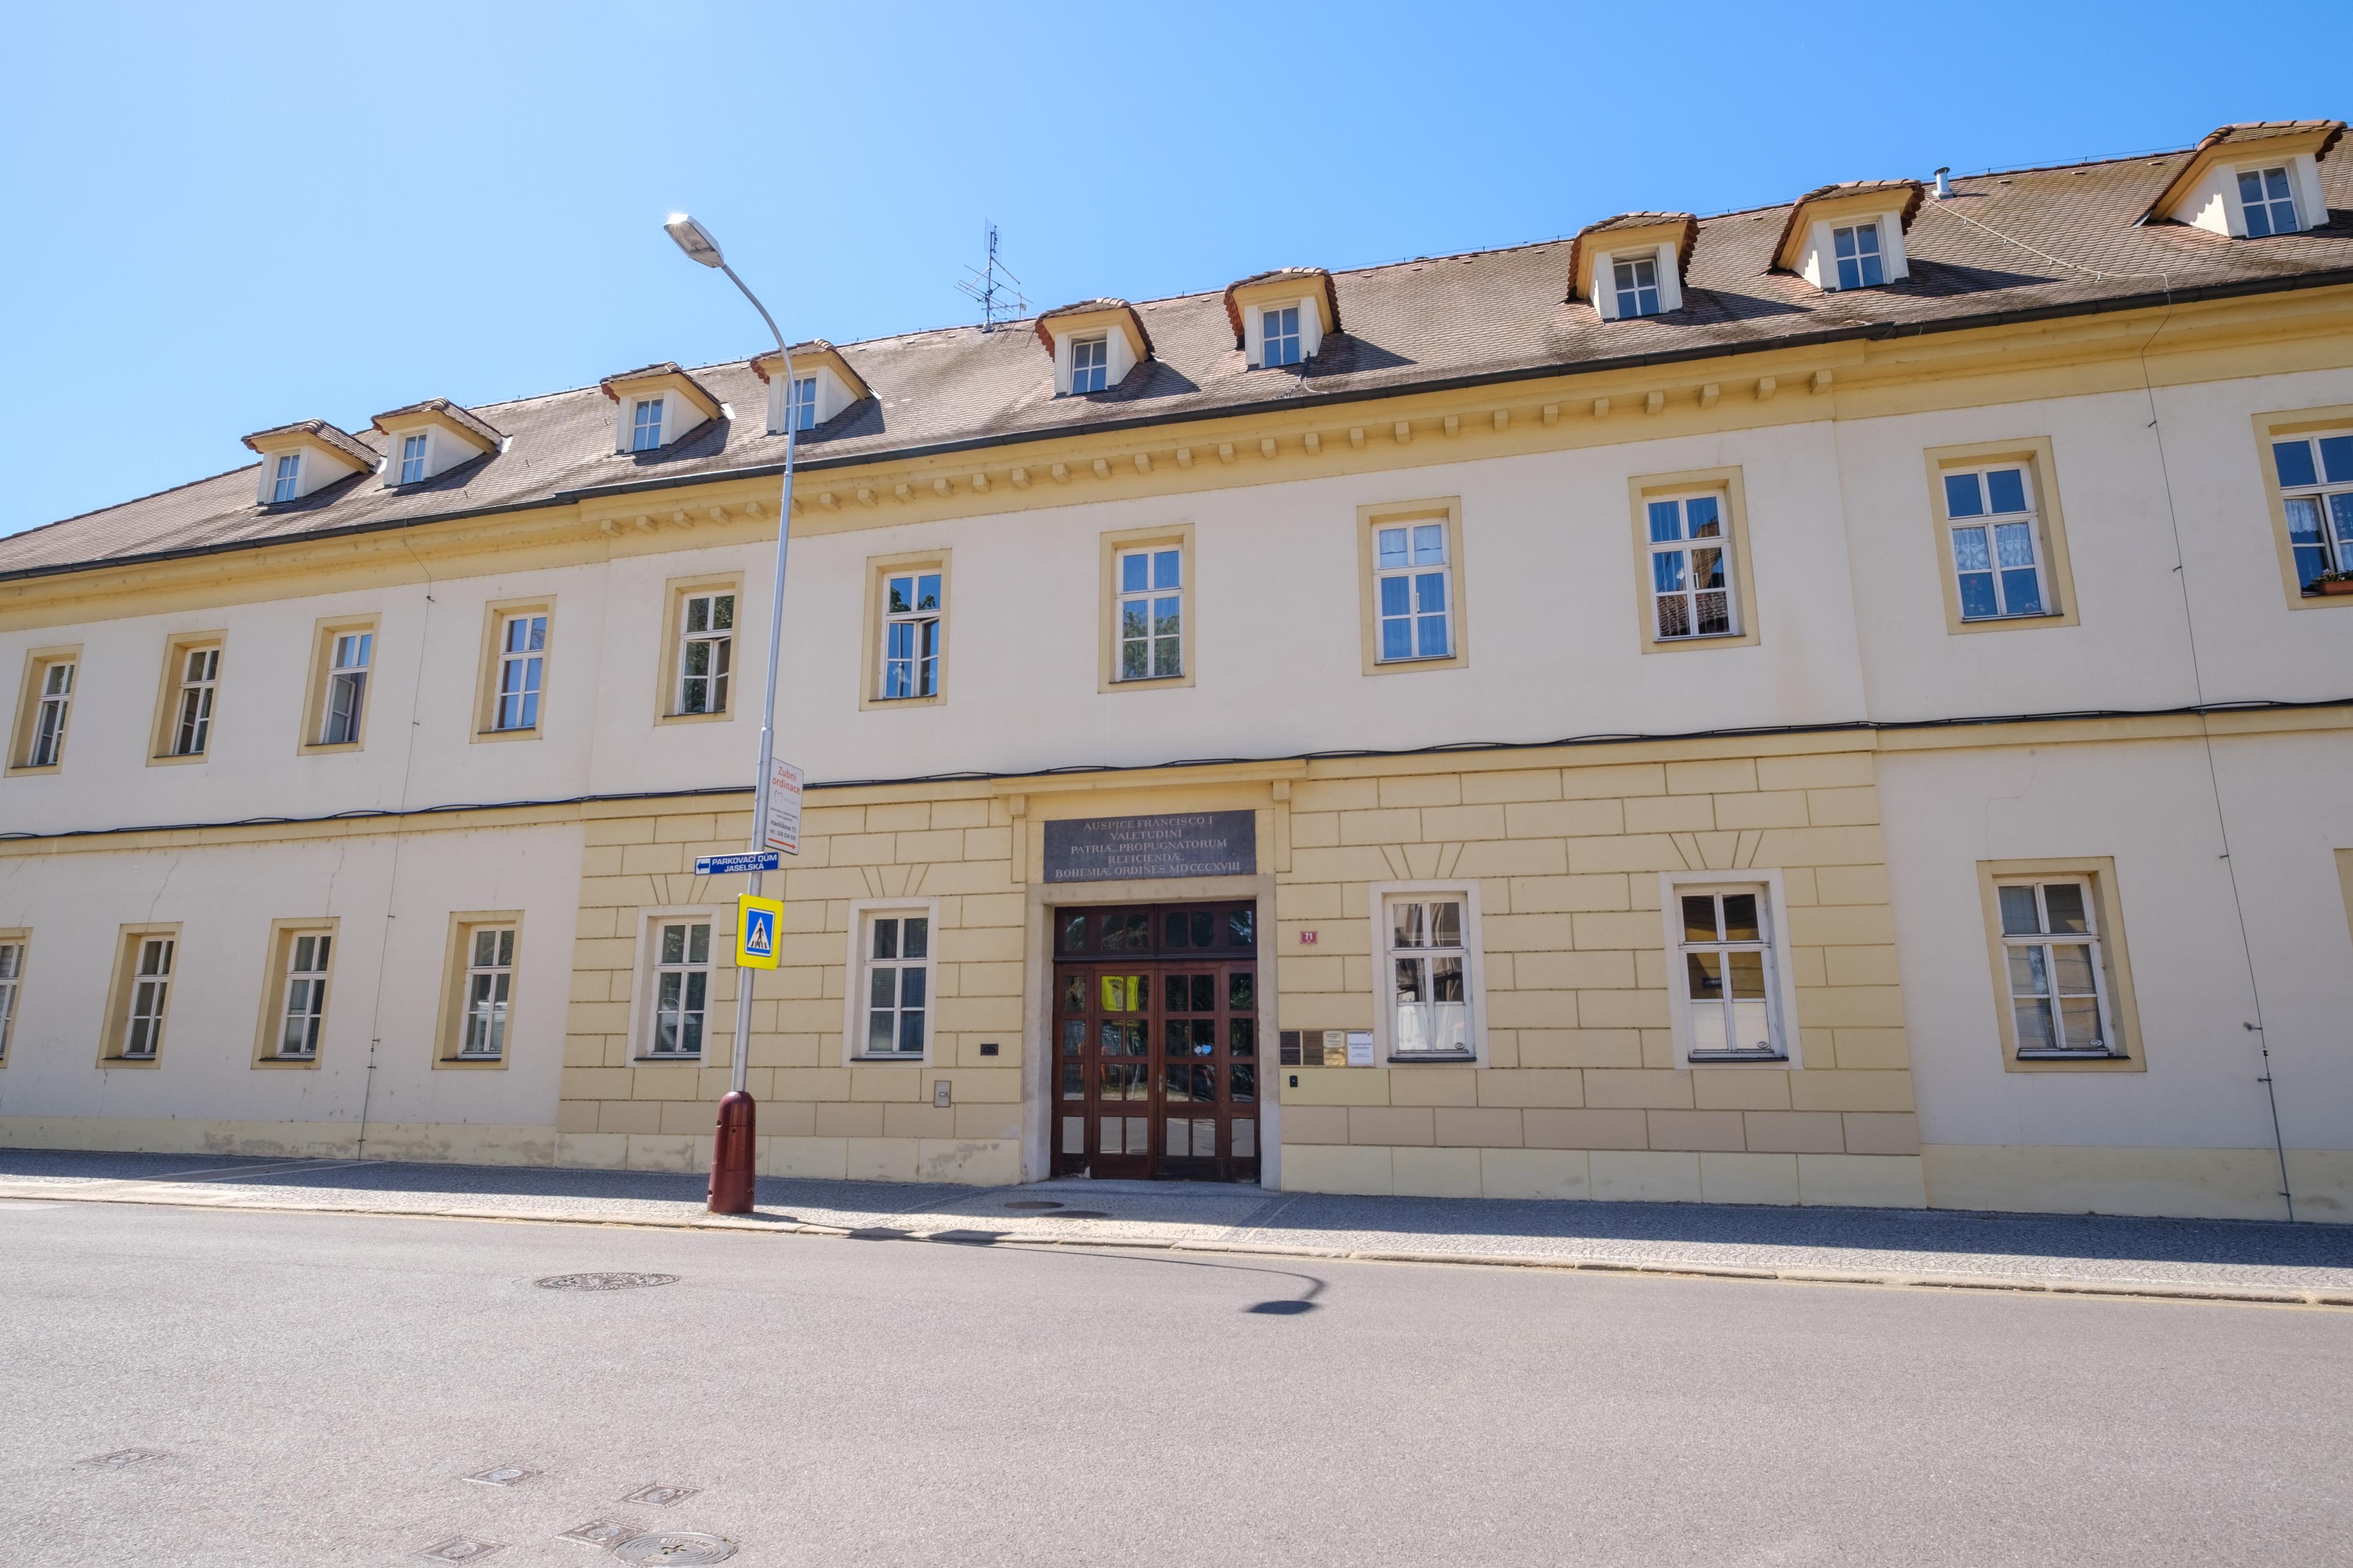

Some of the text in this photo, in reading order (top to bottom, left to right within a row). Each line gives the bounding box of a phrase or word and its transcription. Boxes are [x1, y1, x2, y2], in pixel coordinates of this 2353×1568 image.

[778, 766, 796, 782] Zubní
[772, 778, 801, 795] ordinace
[1084, 820, 1134, 831] AUSPICE
[1138, 817, 1205, 828] FRANCISCO
[1111, 829, 1182, 840] VALETUDINI
[1119, 839, 1227, 852] PROPUGNATORUM
[712, 853, 777, 865] PARKOVACÍ DŮM
[724, 862, 764, 872] JASELSKÁ
[1115, 865, 1165, 875] ORDINES
